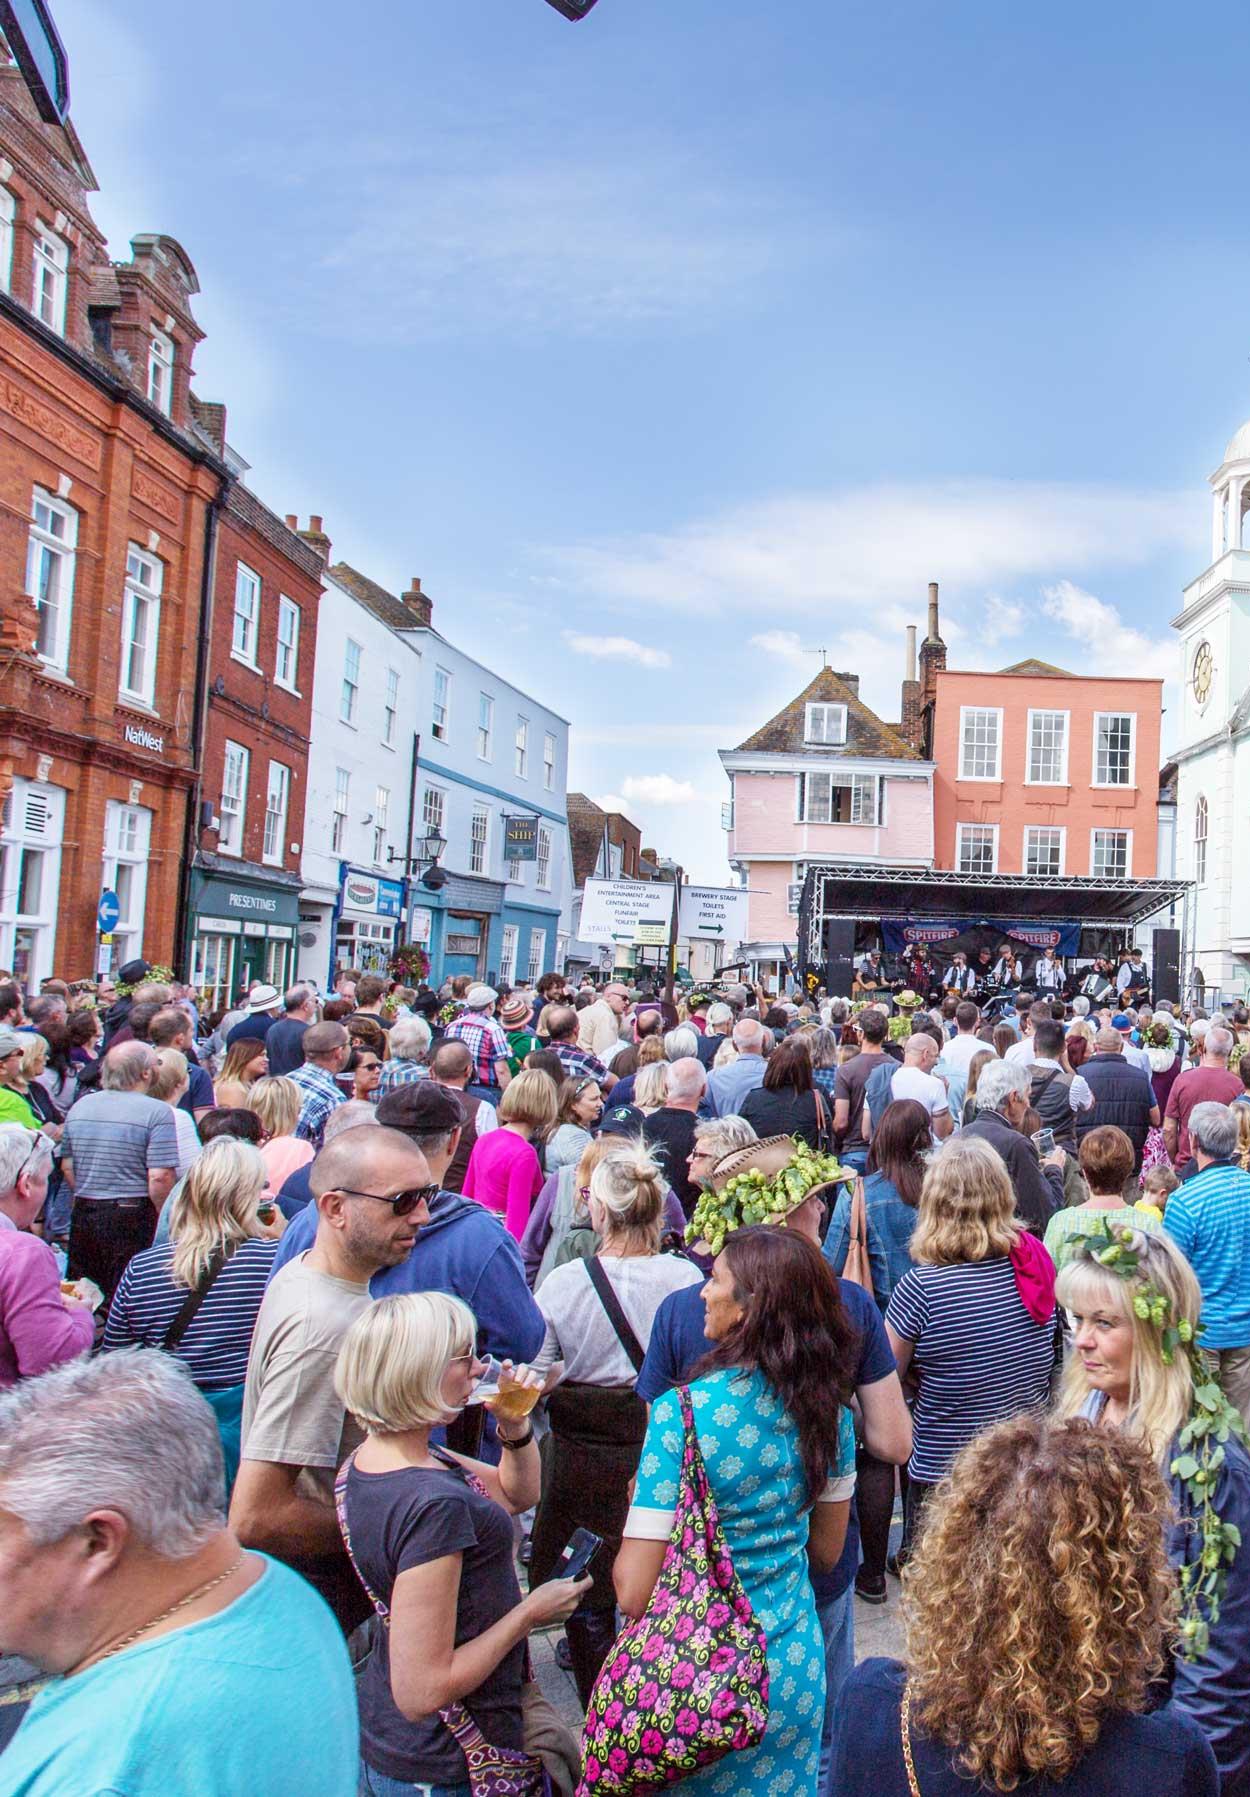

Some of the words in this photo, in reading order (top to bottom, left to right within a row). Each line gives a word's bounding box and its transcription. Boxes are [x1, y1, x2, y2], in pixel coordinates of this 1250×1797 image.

[125, 725, 163, 753] NatWest
[508, 831, 536, 840] SHIP
[598, 891, 644, 899] ENTERTAINMENT
[691, 892, 719, 900] BREWERY
[229, 893, 276, 911] PRESENTIMES
[702, 902, 724, 910] TOILETS
[907, 929, 955, 941] SPITFIRE
